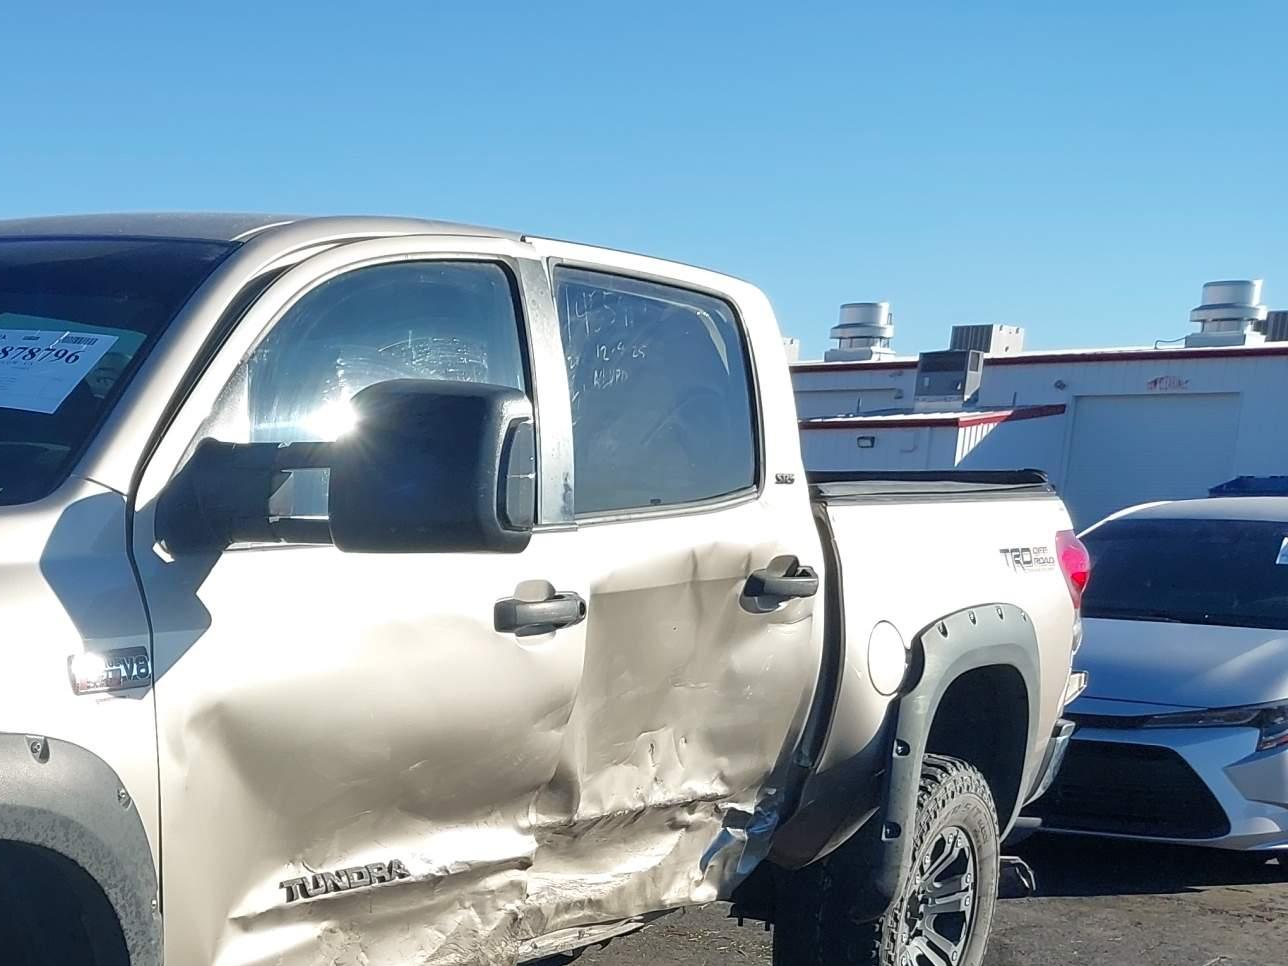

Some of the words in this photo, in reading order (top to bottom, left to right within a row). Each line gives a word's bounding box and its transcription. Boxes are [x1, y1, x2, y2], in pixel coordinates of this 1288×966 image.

[999, 547, 1033, 574] TRD
[1032, 546, 1048, 555] OFF
[1033, 556, 1055, 565] ROAD
[121, 654, 150, 680] V8
[279, 859, 411, 903] TUNDRA
